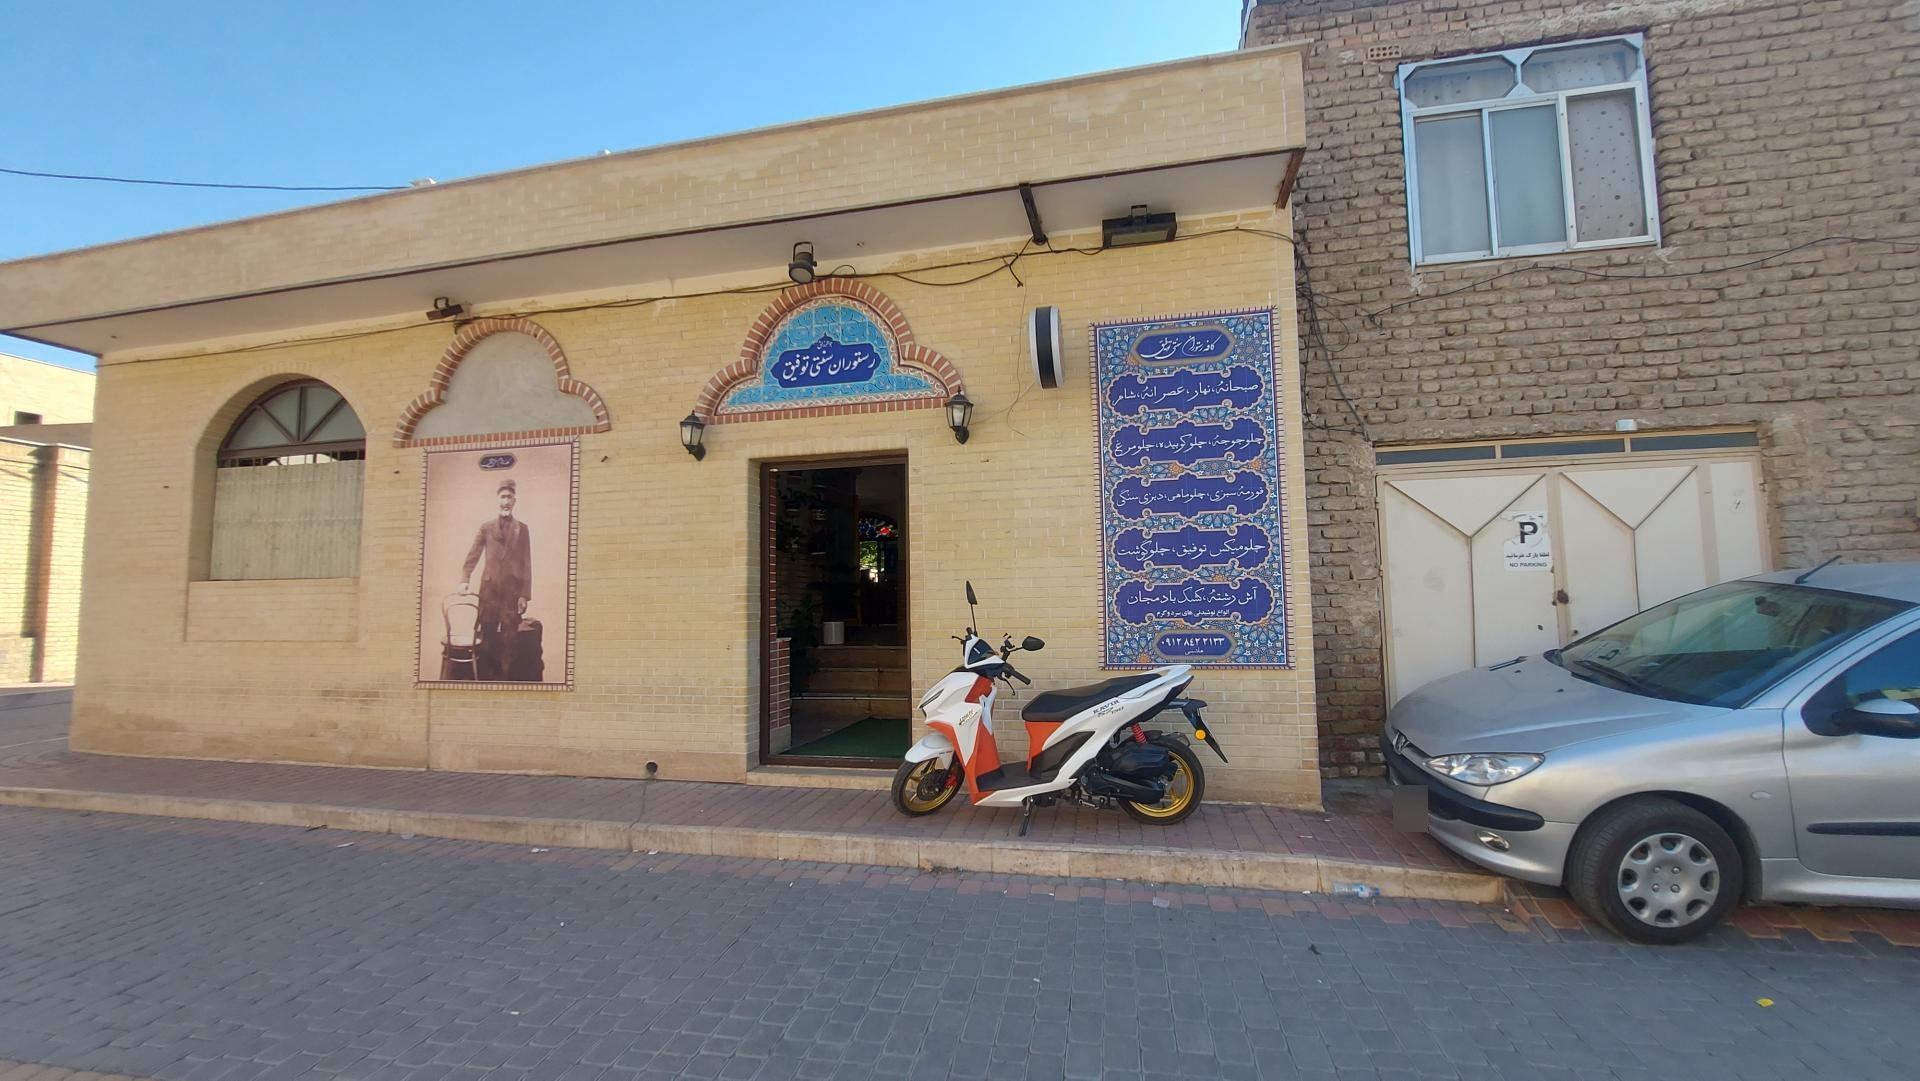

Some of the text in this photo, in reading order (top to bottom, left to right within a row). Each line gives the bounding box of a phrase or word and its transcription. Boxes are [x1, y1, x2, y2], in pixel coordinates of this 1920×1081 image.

[1155, 338, 1182, 359] سنتی
[1181, 336, 1204, 356] رستوران
[1202, 334, 1222, 352] کافه
[782, 350, 876, 382] رستوران سنتی توفیق
[1112, 387, 1136, 406] شام
[1520, 522, 1538, 544] P
[1178, 586, 1206, 604] کشک
[1238, 586, 1257, 605] آش
[1093, 700, 1120, 714] KAVIR
